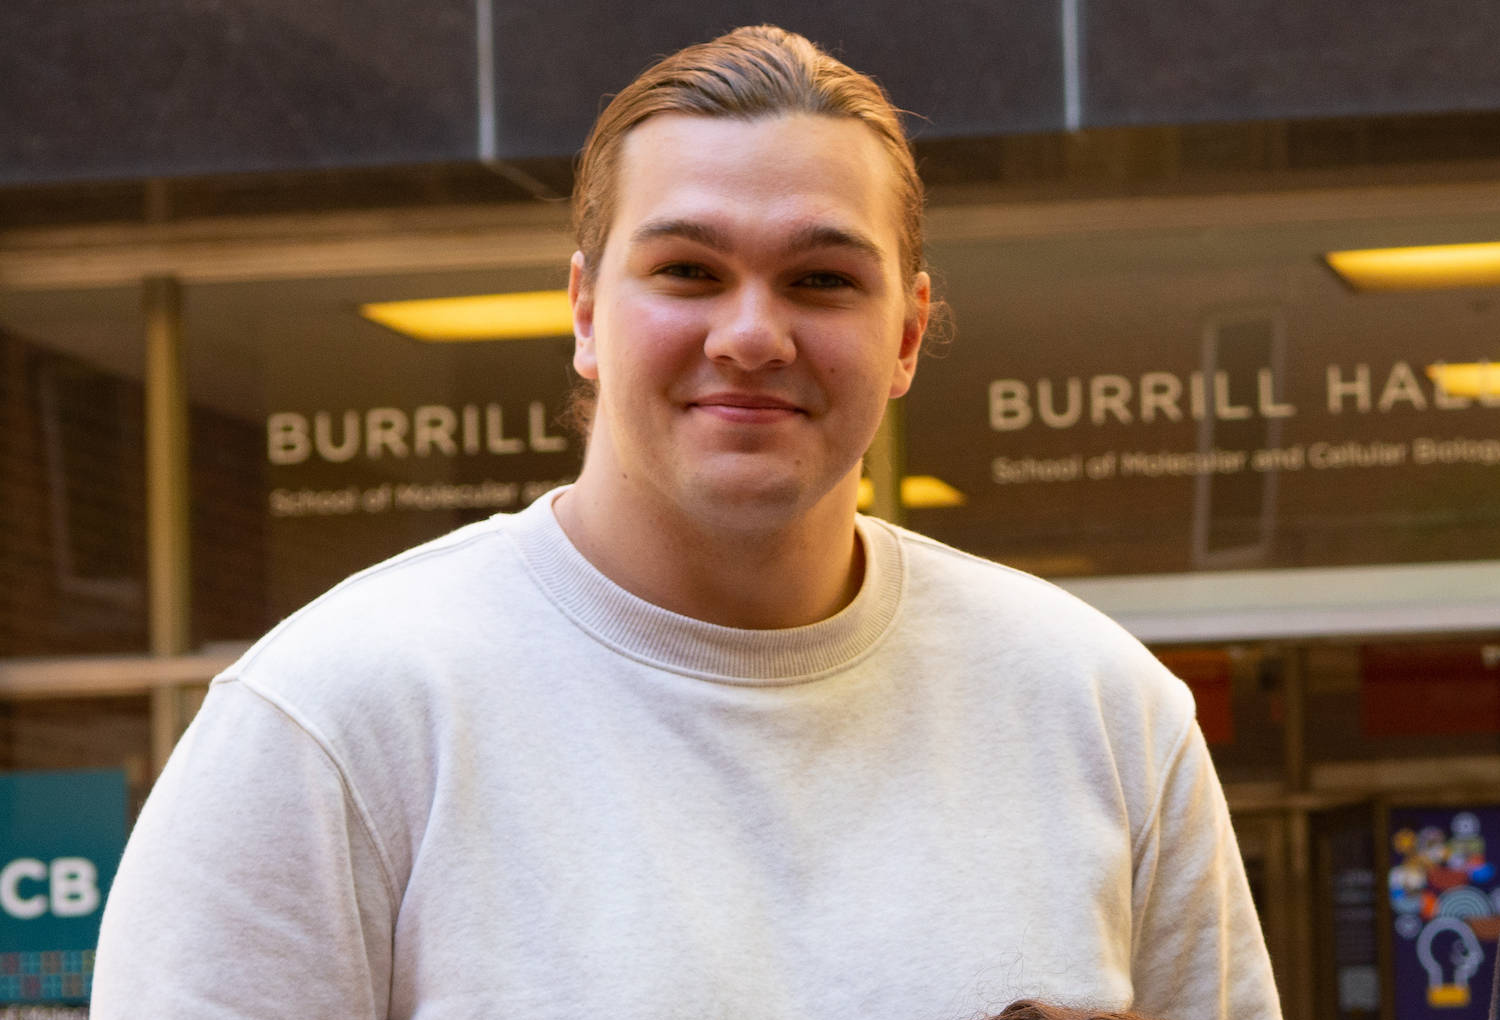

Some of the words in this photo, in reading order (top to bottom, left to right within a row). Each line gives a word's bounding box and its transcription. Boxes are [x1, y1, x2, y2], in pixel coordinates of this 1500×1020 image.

[988, 368, 1297, 432] BURRILL
[267, 404, 566, 464] BURRILL
[992, 456, 1082, 484] School
[1085, 452, 1115, 480] of
[1120, 450, 1245, 478] Molecular
[1251, 444, 1304, 472] and
[1308, 442, 1405, 470] Cellular
[270, 487, 358, 517] School
[361, 483, 392, 514] of
[396, 479, 518, 511] Molecular
